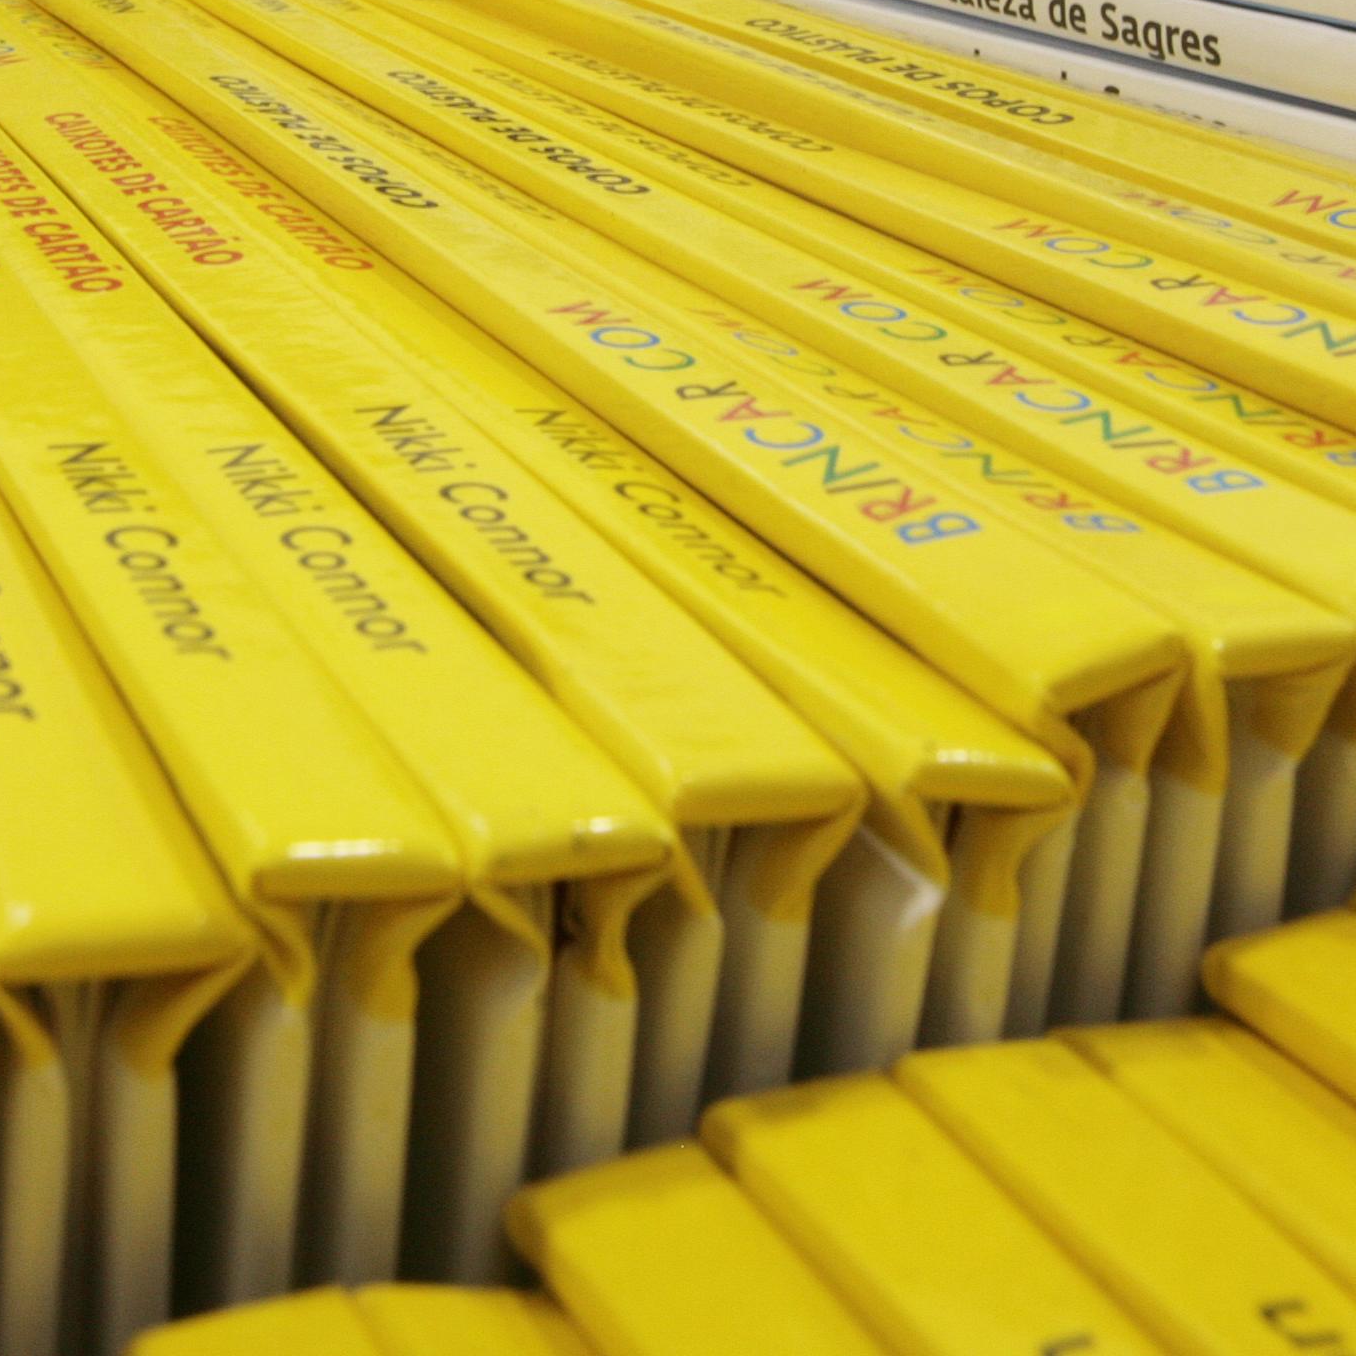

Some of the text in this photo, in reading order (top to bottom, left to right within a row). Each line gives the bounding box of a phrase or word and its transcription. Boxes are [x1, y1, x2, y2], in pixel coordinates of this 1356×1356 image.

[744, 18, 895, 63] PLÁSTICO
[1100, 1, 1223, 67] Sagres
[879, 62, 946, 80] DE
[930, 75, 1075, 125] COPOS
[0, 194, 58, 218] DE
[44, 111, 245, 267] CAIXOTES DE CARTÃO
[22, 220, 125, 293] CARTÃO
[992, 217, 1155, 270] COM
[789, 277, 1268, 495] BRINCAR COM
[546, 299, 985, 546] BRINCAR COM
[352, 404, 597, 606] Nikki Connor
[205, 442, 429, 656] Nikki Connor
